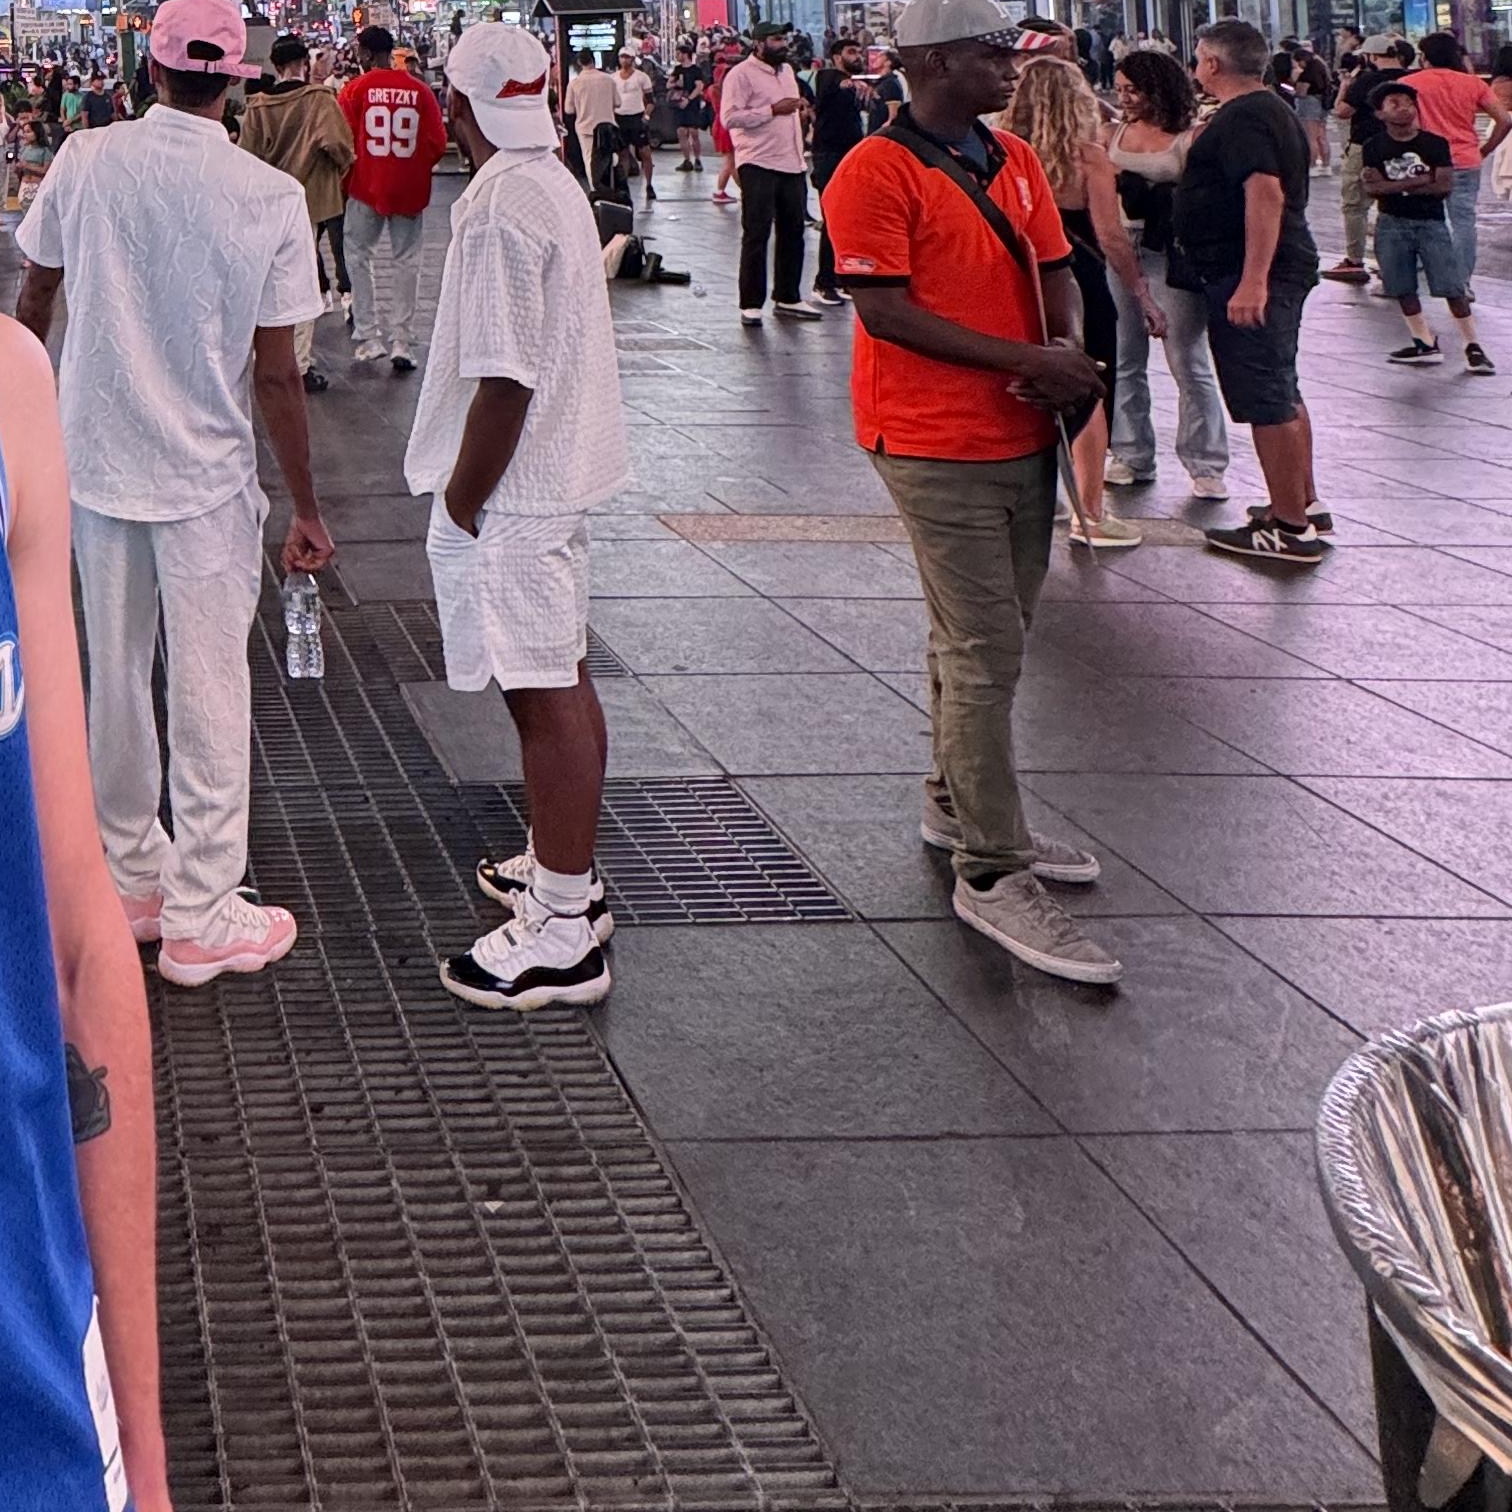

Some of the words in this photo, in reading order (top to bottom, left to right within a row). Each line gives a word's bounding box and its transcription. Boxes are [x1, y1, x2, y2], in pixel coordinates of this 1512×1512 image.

[367, 87, 419, 106] GRETZKY
[364, 105, 420, 159] 99
[1250, 528, 1288, 552] AX
